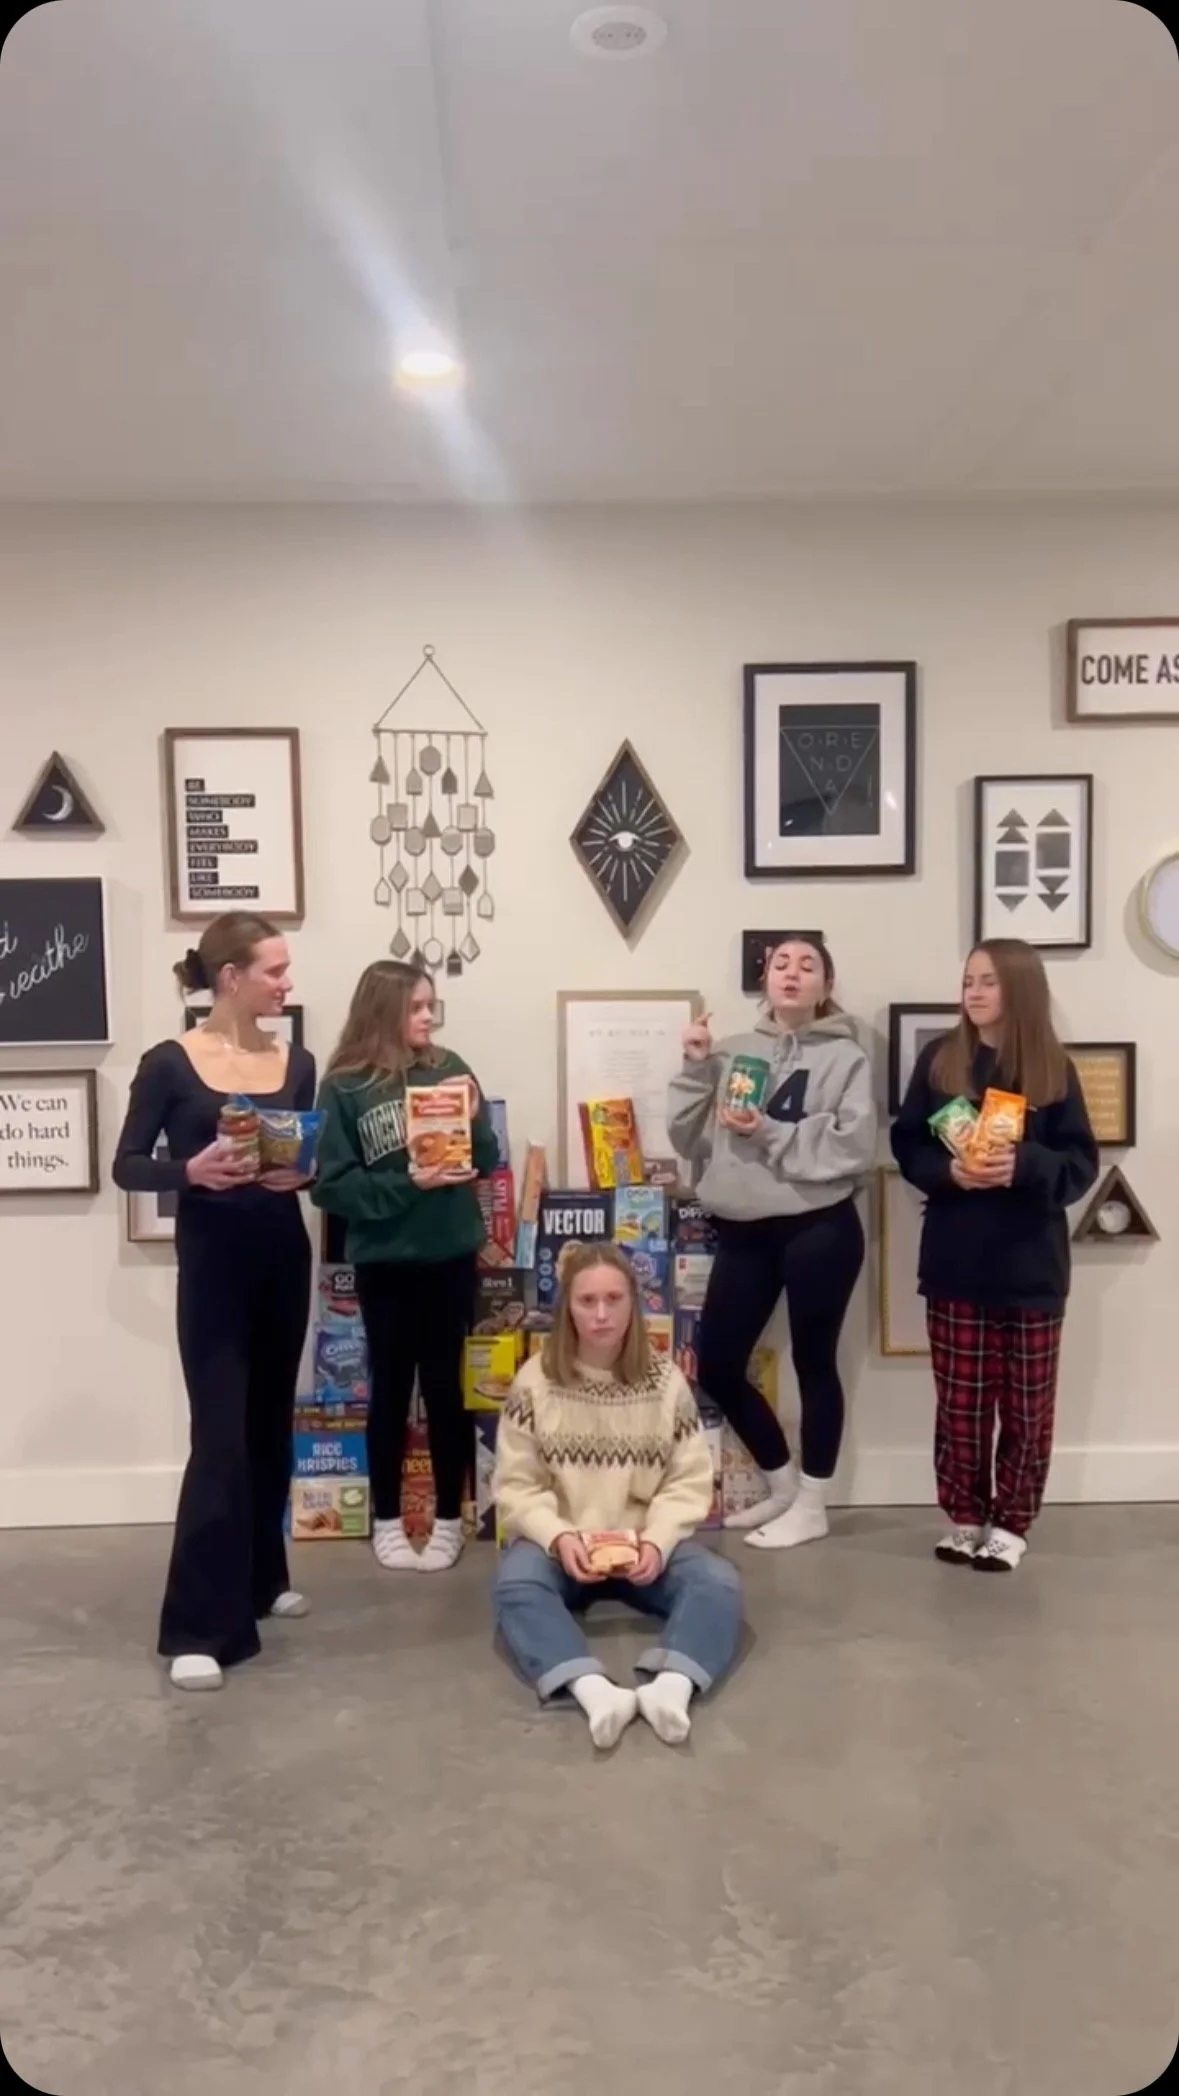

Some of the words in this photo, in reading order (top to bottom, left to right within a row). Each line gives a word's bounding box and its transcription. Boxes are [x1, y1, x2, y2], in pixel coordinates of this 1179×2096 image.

[1081, 653, 1149, 686] COME
[1156, 653, 1179, 685] AS
[0, 1093, 32, 1112] We
[35, 1097, 68, 1112] can
[766, 1068, 811, 1124] 4
[0, 1122, 24, 1141] do
[28, 1120, 70, 1140] hard
[7, 1150, 70, 1173] things.
[543, 1207, 605, 1235] VECTOR
[333, 1273, 355, 1284] GO
